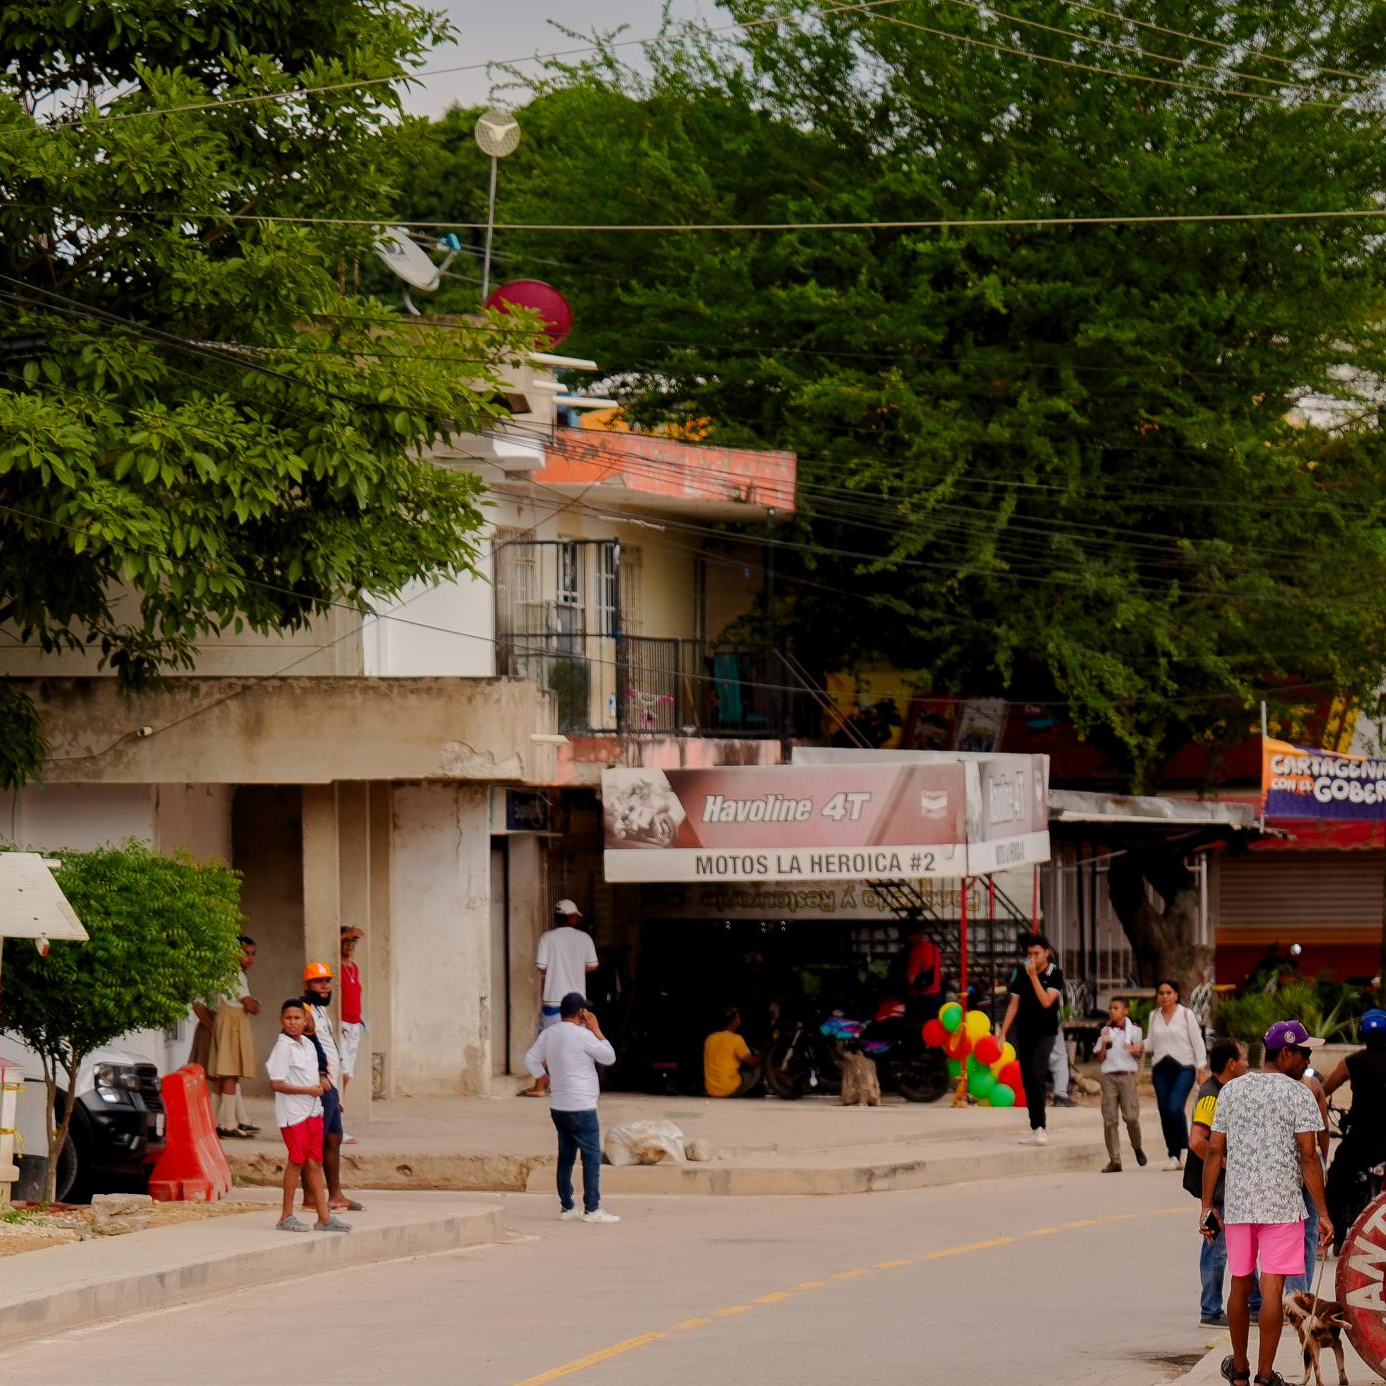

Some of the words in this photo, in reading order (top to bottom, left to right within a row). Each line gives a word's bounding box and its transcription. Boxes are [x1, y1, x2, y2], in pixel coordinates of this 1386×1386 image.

[701, 792, 812, 825] Havoline
[821, 791, 873, 822] 4T
[695, 853, 769, 875] MOTOS
[776, 853, 803, 874] LA
[810, 852, 902, 874] HEROICA
[909, 851, 937, 872] #2
